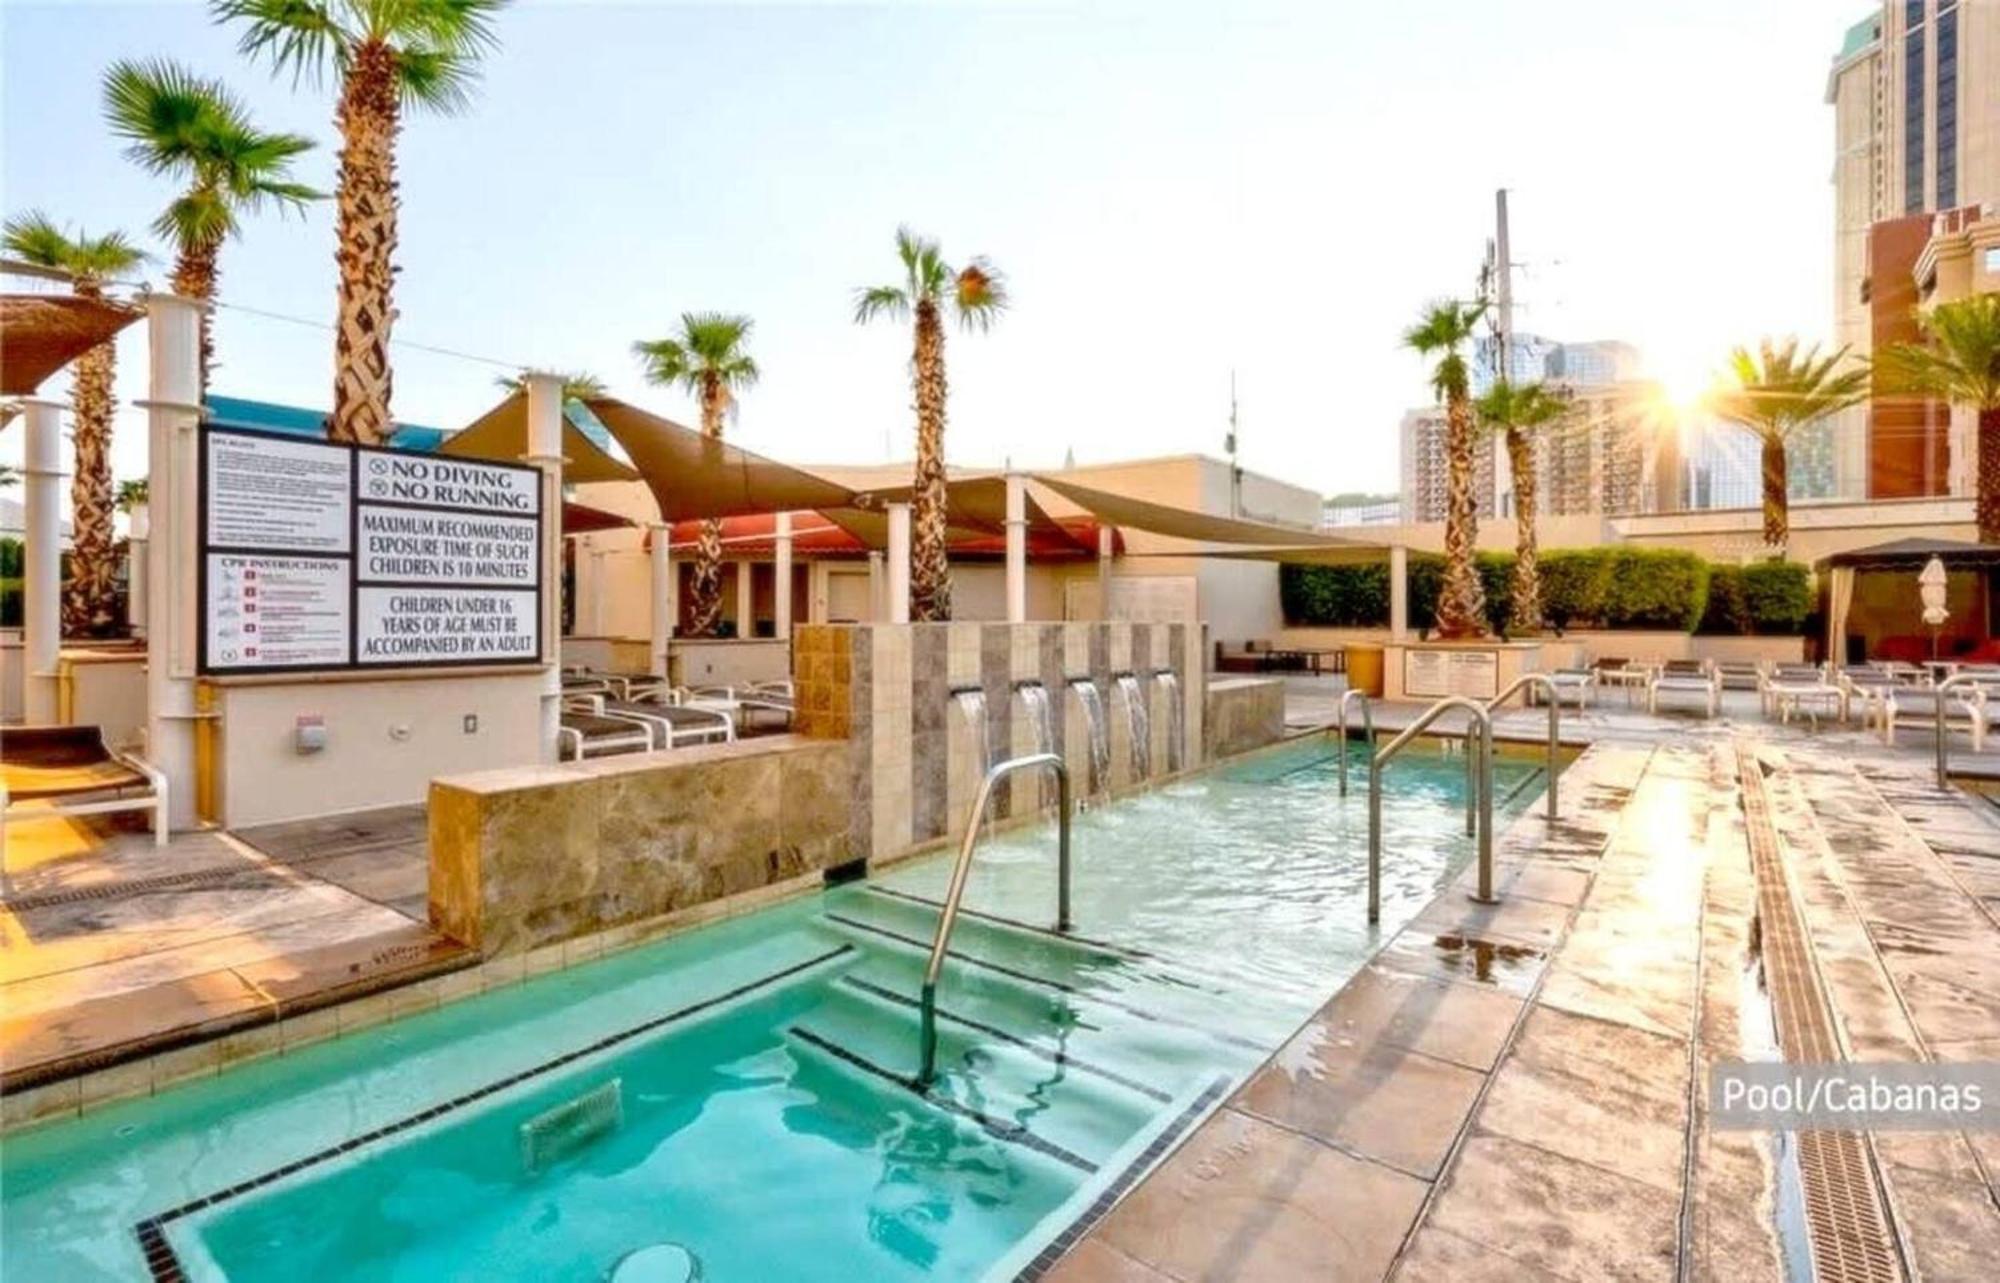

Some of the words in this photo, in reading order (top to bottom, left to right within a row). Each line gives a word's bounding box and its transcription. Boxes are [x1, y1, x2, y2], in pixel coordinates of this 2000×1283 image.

[392, 461, 428, 479] NO
[434, 465, 512, 488] DIVING
[392, 482, 428, 499] NO
[434, 486, 529, 508] RUNNING
[364, 516, 434, 535] MAXIMUM
[438, 519, 534, 541] RECOMMENDED
[369, 536, 439, 556] EXPOSURE
[443, 539, 473, 557] TIME
[476, 541, 494, 559] OF
[496, 544, 529, 560] SUCH
[221, 558, 247, 568] CPR
[250, 559, 339, 571] INSTRUCTIONS
[369, 557, 439, 576] CHILDREN
[442, 559, 455, 577] IS
[458, 560, 473, 577] 10
[475, 562, 529, 579] MINUTES
[389, 596, 453, 614] CHILDREN
[456, 598, 496, 614] UNDER
[500, 599, 512, 614] 16
[381, 617, 421, 635] YEARS
[423, 617, 440, 633] OF
[443, 617, 467, 633] AGE
[470, 616, 502, 632] MUST
[504, 616, 518, 631] BE
[364, 637, 459, 656] ACCOMPANIED
[461, 637, 477, 652] BY
[478, 637, 495, 651] AN
[497, 636, 532, 651] ADULT
